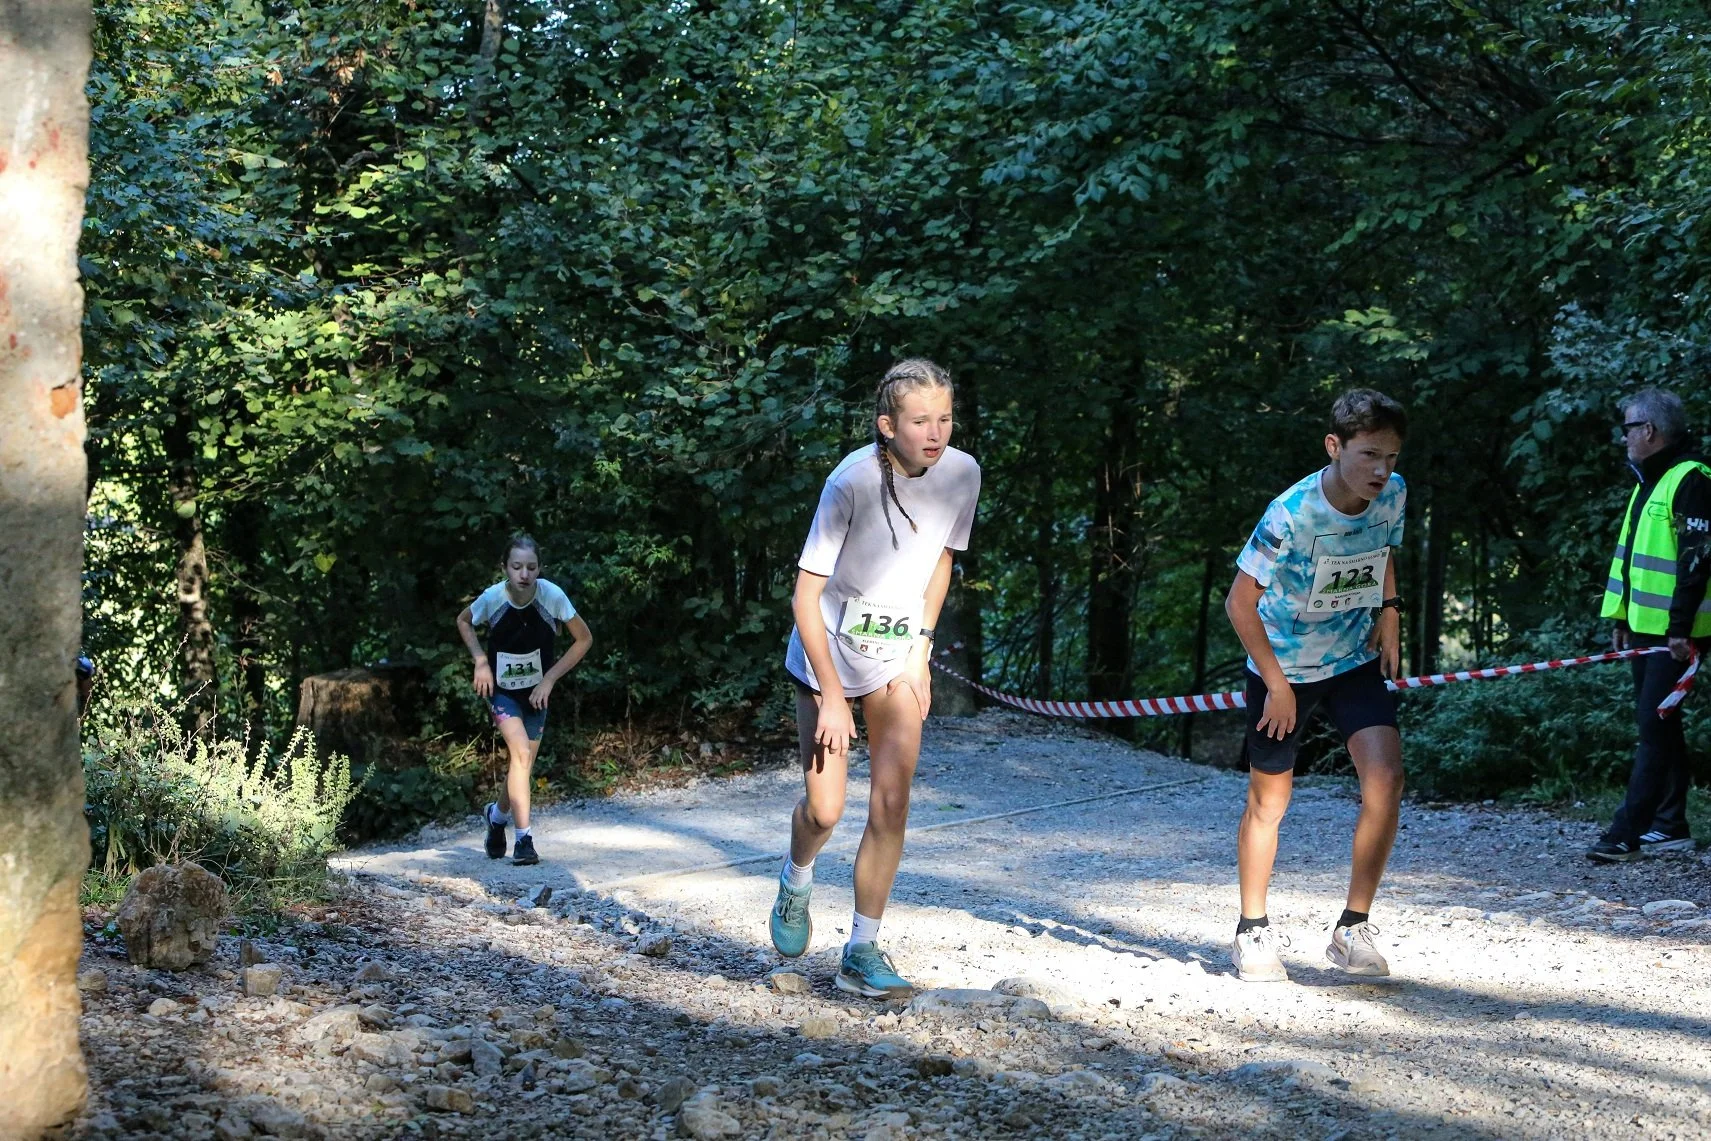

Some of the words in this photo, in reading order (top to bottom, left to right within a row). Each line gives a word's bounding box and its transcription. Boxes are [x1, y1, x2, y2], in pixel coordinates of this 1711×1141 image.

[1332, 566, 1374, 589] 123
[862, 613, 909, 637] 136
[506, 661, 533, 677] 131
